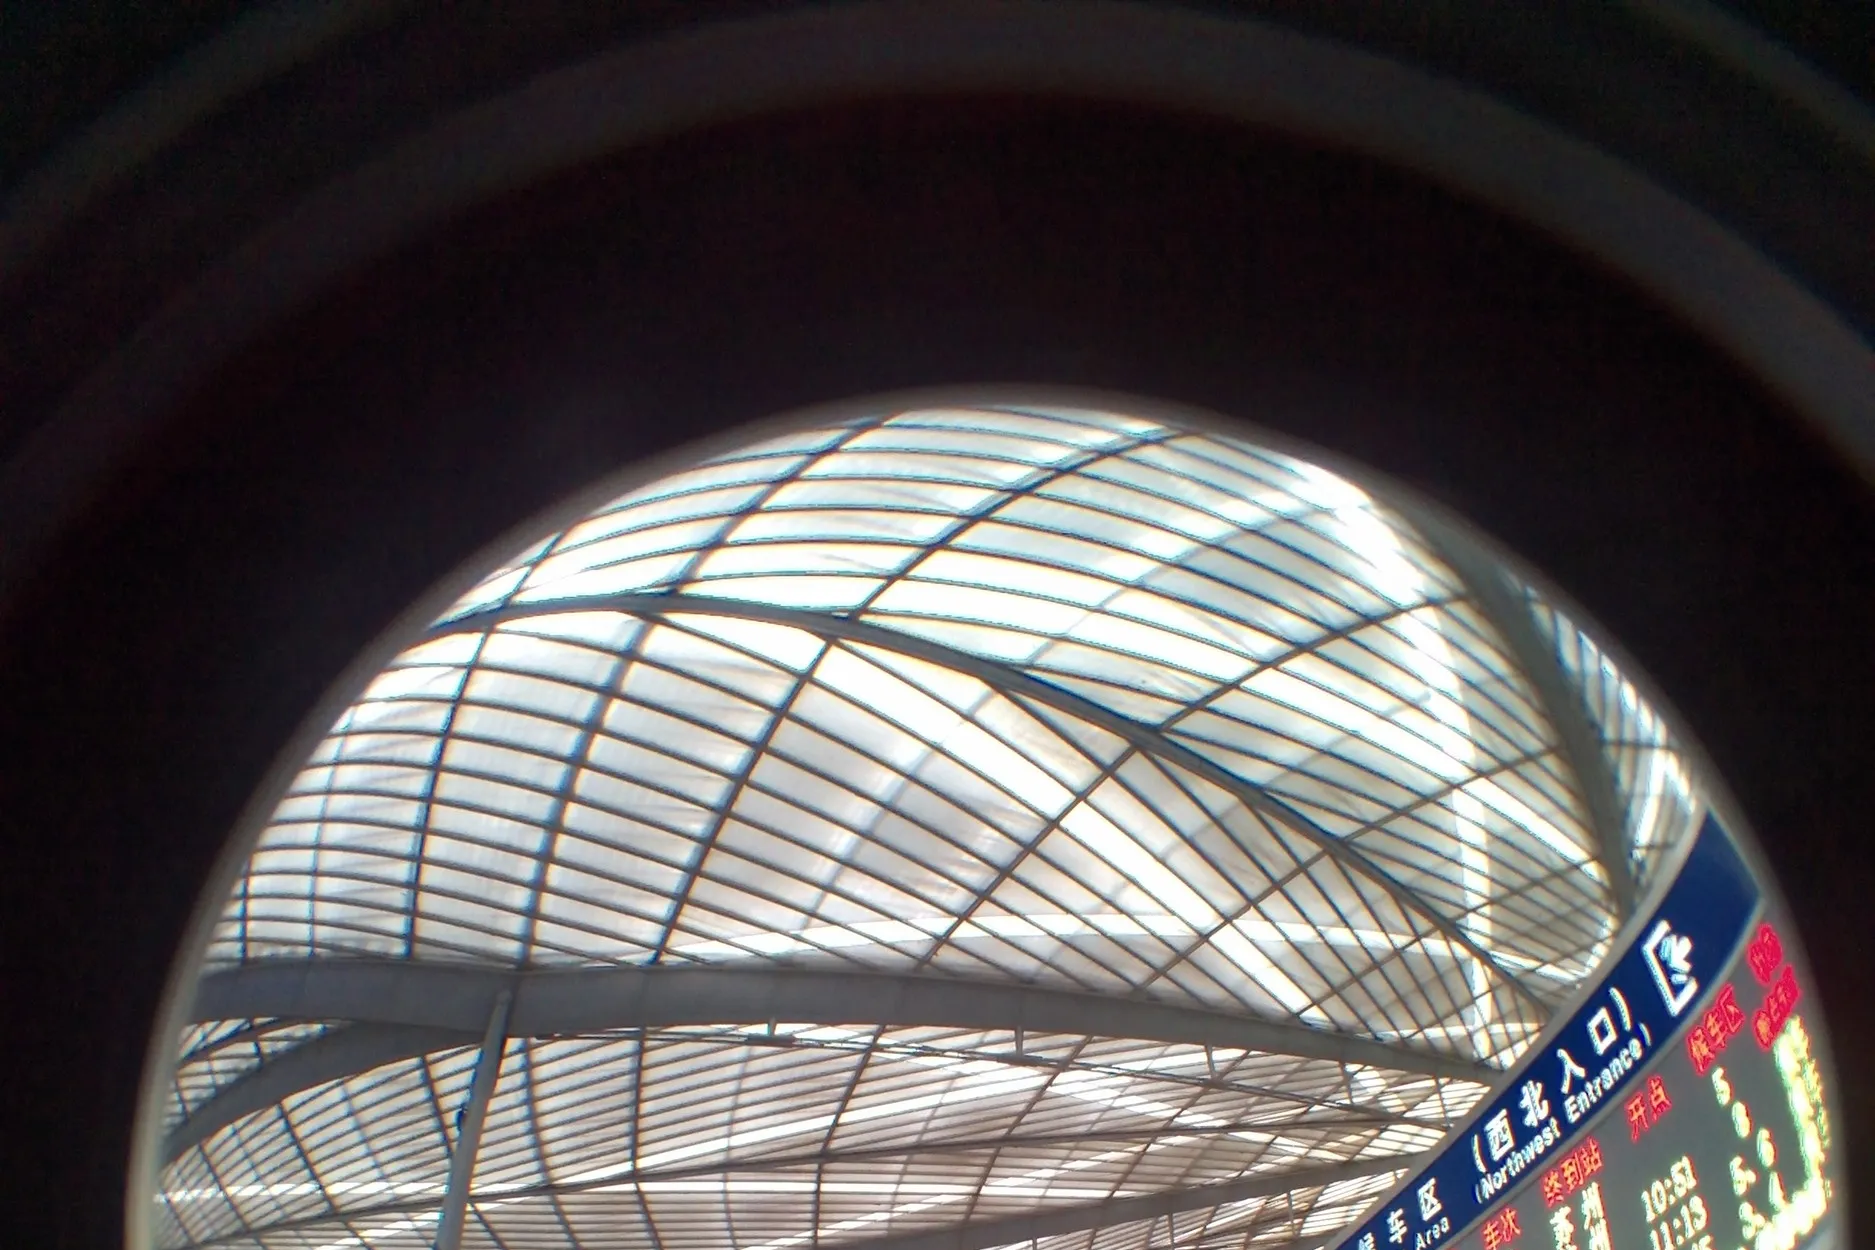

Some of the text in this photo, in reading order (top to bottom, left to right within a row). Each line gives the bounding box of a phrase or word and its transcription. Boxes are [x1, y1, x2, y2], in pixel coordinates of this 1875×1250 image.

[1475, 1116, 1561, 1204] (Northwest
[1564, 1022, 1651, 1124] Entrance)
[1625, 1074, 1673, 1143] 开点
[1641, 1156, 1697, 1222] 10:51
